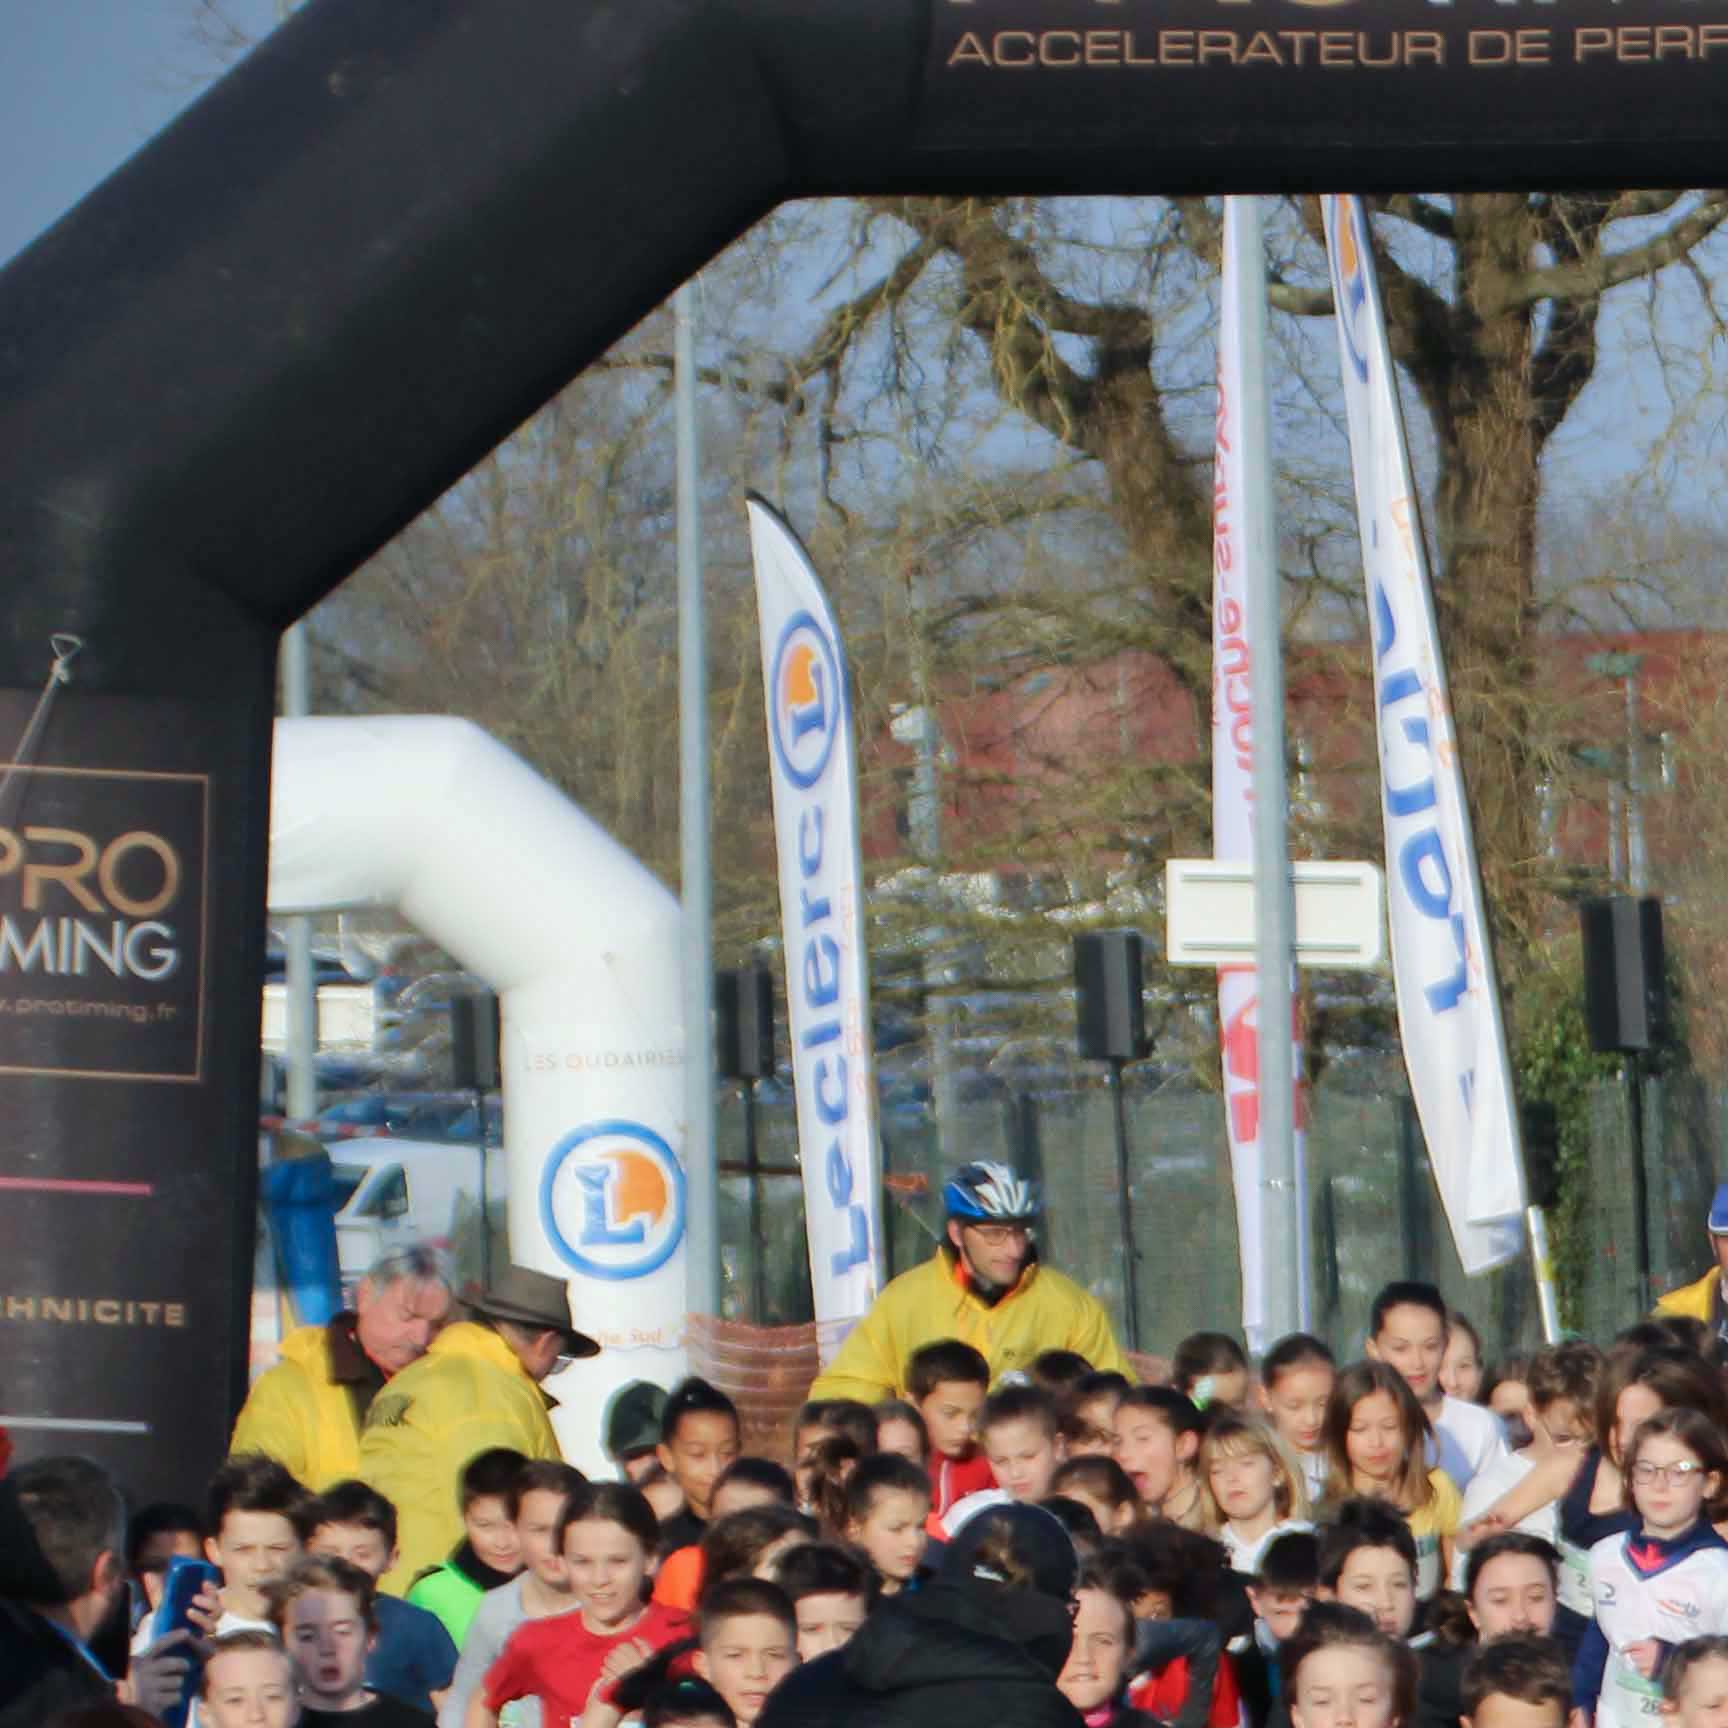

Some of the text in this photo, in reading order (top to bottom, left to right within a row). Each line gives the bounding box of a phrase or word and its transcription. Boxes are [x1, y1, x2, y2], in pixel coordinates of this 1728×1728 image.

[947, 30, 1444, 66] ACCELERATEUR
[1468, 29, 1552, 65] DE
[799, 804, 870, 1276] Leclerc
[0, 1295, 187, 1327] HNICITE
